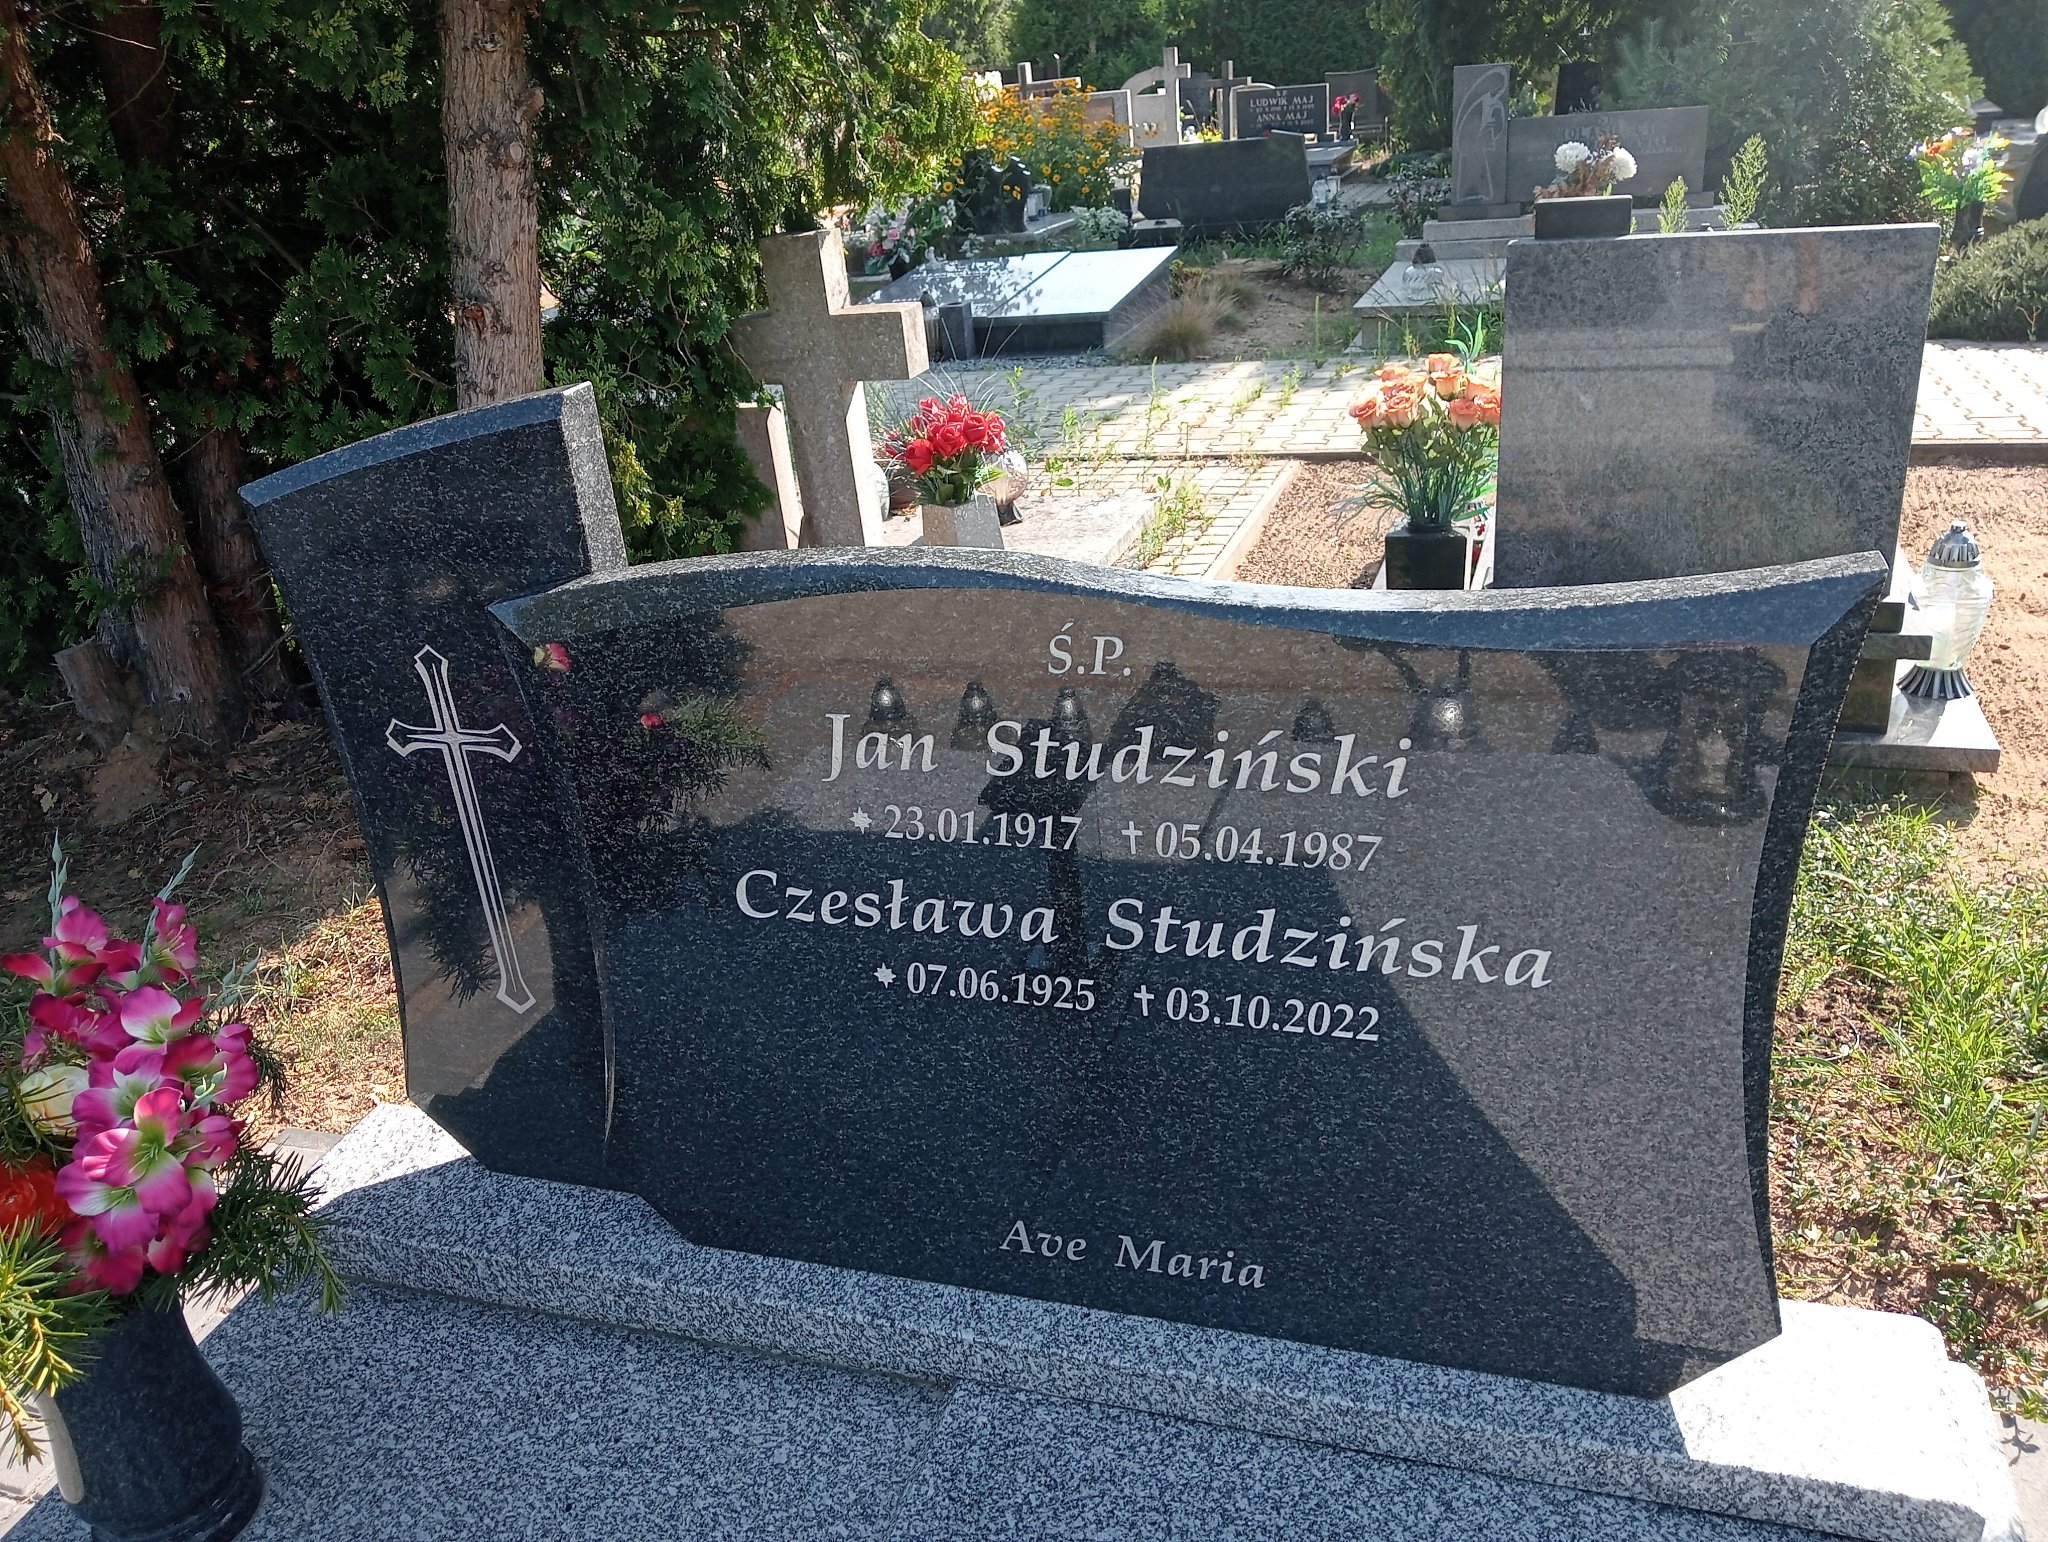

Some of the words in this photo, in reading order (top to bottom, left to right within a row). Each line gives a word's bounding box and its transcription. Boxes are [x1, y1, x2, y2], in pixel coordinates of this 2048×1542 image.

[1250, 96, 1288, 108] LUDWIK
[1292, 95, 1314, 104] MAJ
[1256, 113, 1281, 122] ANNA
[1285, 111, 1308, 120] MAJ
[1047, 622, 1132, 677] Ś.P.
[822, 713, 938, 782] Jan
[985, 720, 1412, 798] Studziński
[884, 804, 1082, 851] 23.01.1917
[1155, 821, 1383, 872] 05.04.1987
[735, 869, 1060, 944] Czesława
[1105, 898, 1553, 988] Studzińska
[907, 962, 1096, 1011] 07.06.1925
[1166, 987, 1380, 1042] 03.10.2022
[999, 1220, 1087, 1261] Ave
[1114, 1235, 1265, 1288] Maria
